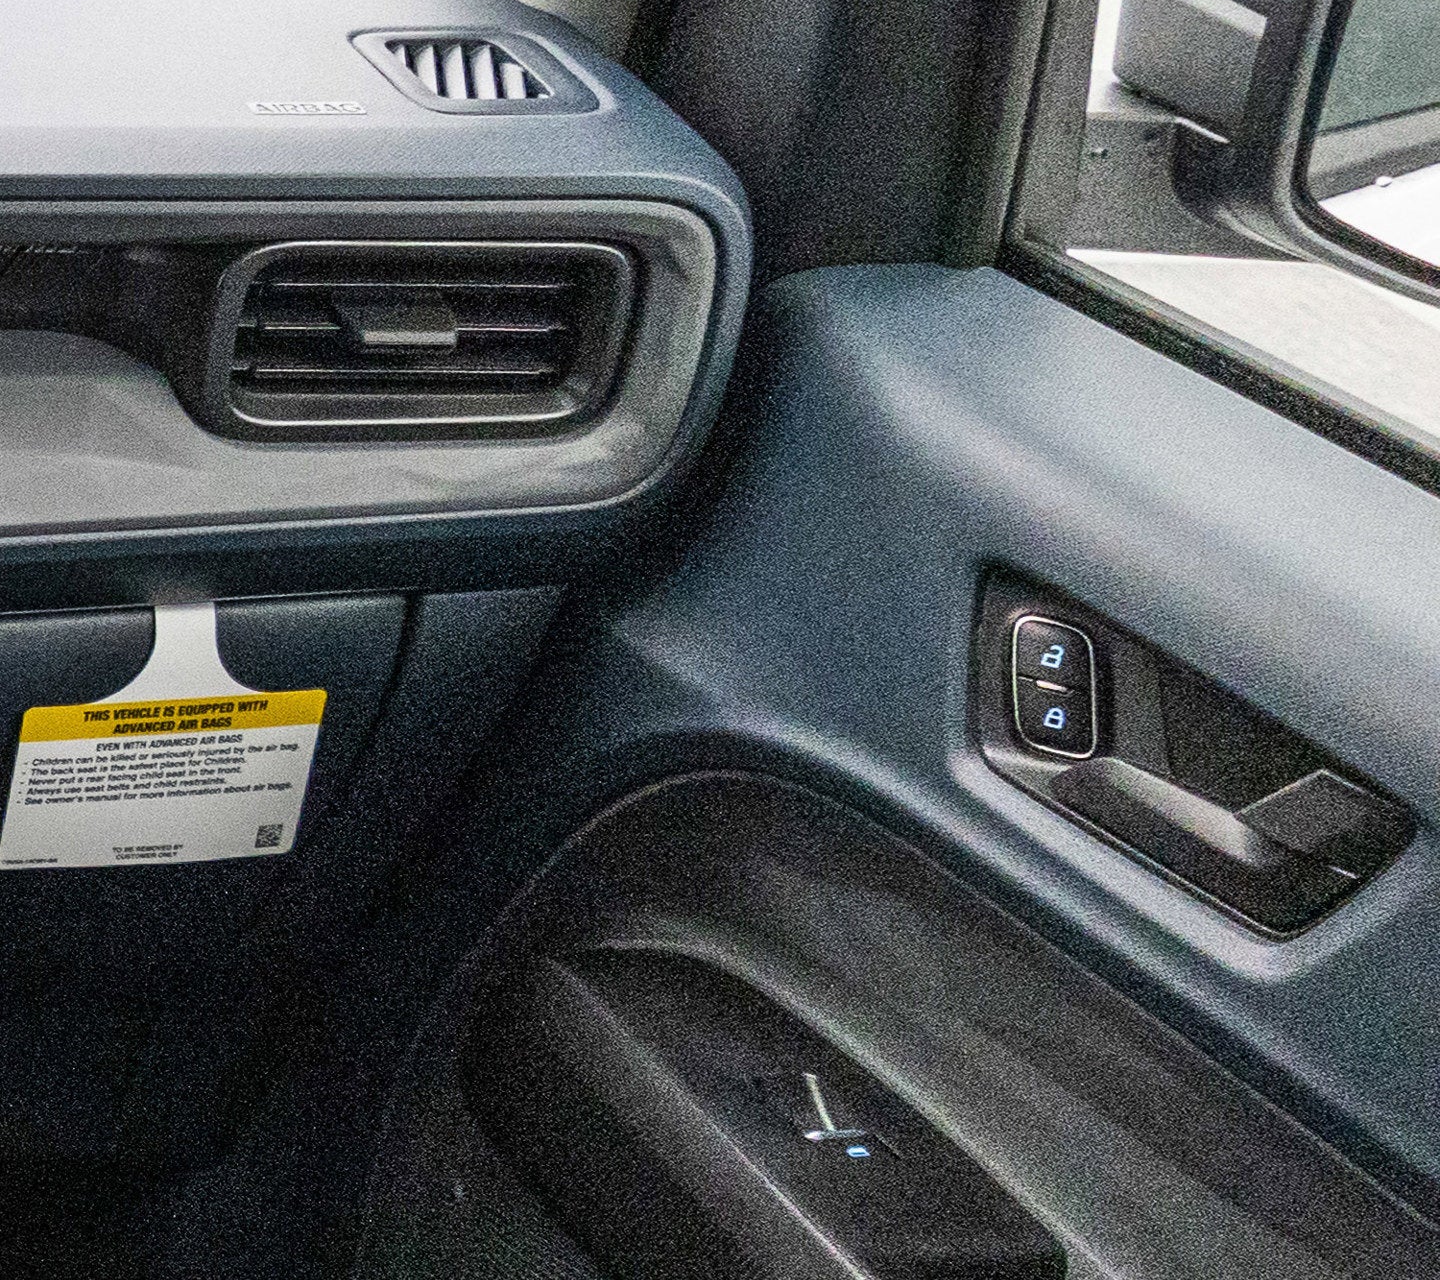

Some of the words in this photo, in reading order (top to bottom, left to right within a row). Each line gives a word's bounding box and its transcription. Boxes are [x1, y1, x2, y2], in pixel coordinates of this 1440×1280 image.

[253, 102, 364, 114] AIRBAG
[83, 709, 109, 721] THIS
[113, 706, 159, 719] VEHICLE
[162, 706, 173, 716] IS
[178, 702, 233, 716] EQUIPPED
[238, 700, 268, 712] WITH
[113, 720, 175, 733] ADVANCED
[178, 719, 198, 730] AIR
[200, 717, 231, 728] BAGS
[96, 742, 119, 751] EVEN
[123, 740, 146, 749] WITH
[149, 737, 196, 748] ADVANCED
[199, 736, 215, 745] AIR
[218, 734, 242, 744] BAGS
[32, 756, 73, 766] Children
[96, 754, 107, 762] be
[110, 752, 136, 761] killed
[151, 750, 194, 760] seriously
[198, 747, 230, 757] injured
[233, 746, 244, 755] by
[247, 745, 262, 753] the
[265, 744, 276, 752] air
[280, 743, 299, 752] bag.
[28, 776, 56, 785] Never
[58, 775, 75, 785] put
[107, 772, 136, 782] facing
[139, 770, 162, 779] child
[165, 769, 185, 777] seat
[188, 768, 197, 776] in
[200, 767, 215, 775] the
[217, 765, 241, 774] front.
[31, 767, 48, 776] The
[51, 766, 73, 774] back
[77, 764, 96, 773] seat
[99, 764, 107, 772] is
[110, 763, 126, 771] the
[128, 761, 157, 770] safest
[159, 759, 184, 769] place
[188, 758, 200, 766] for
[204, 755, 245, 765] Children.
[24, 796, 42, 805] See
[45, 794, 82, 804] owner's
[85, 792, 120, 801] manual
[123, 791, 136, 799] for
[139, 790, 164, 798] more
[166, 786, 221, 796] information
[224, 784, 250, 793] about
[252, 783, 264, 791] air
[267, 782, 292, 792] bags.
[26, 786, 60, 797] Always
[84, 783, 104, 792] seat
[107, 782, 129, 791] belts
[133, 780, 150, 789] and
[153, 779, 177, 788] child
[179, 776, 226, 786] restraints.
